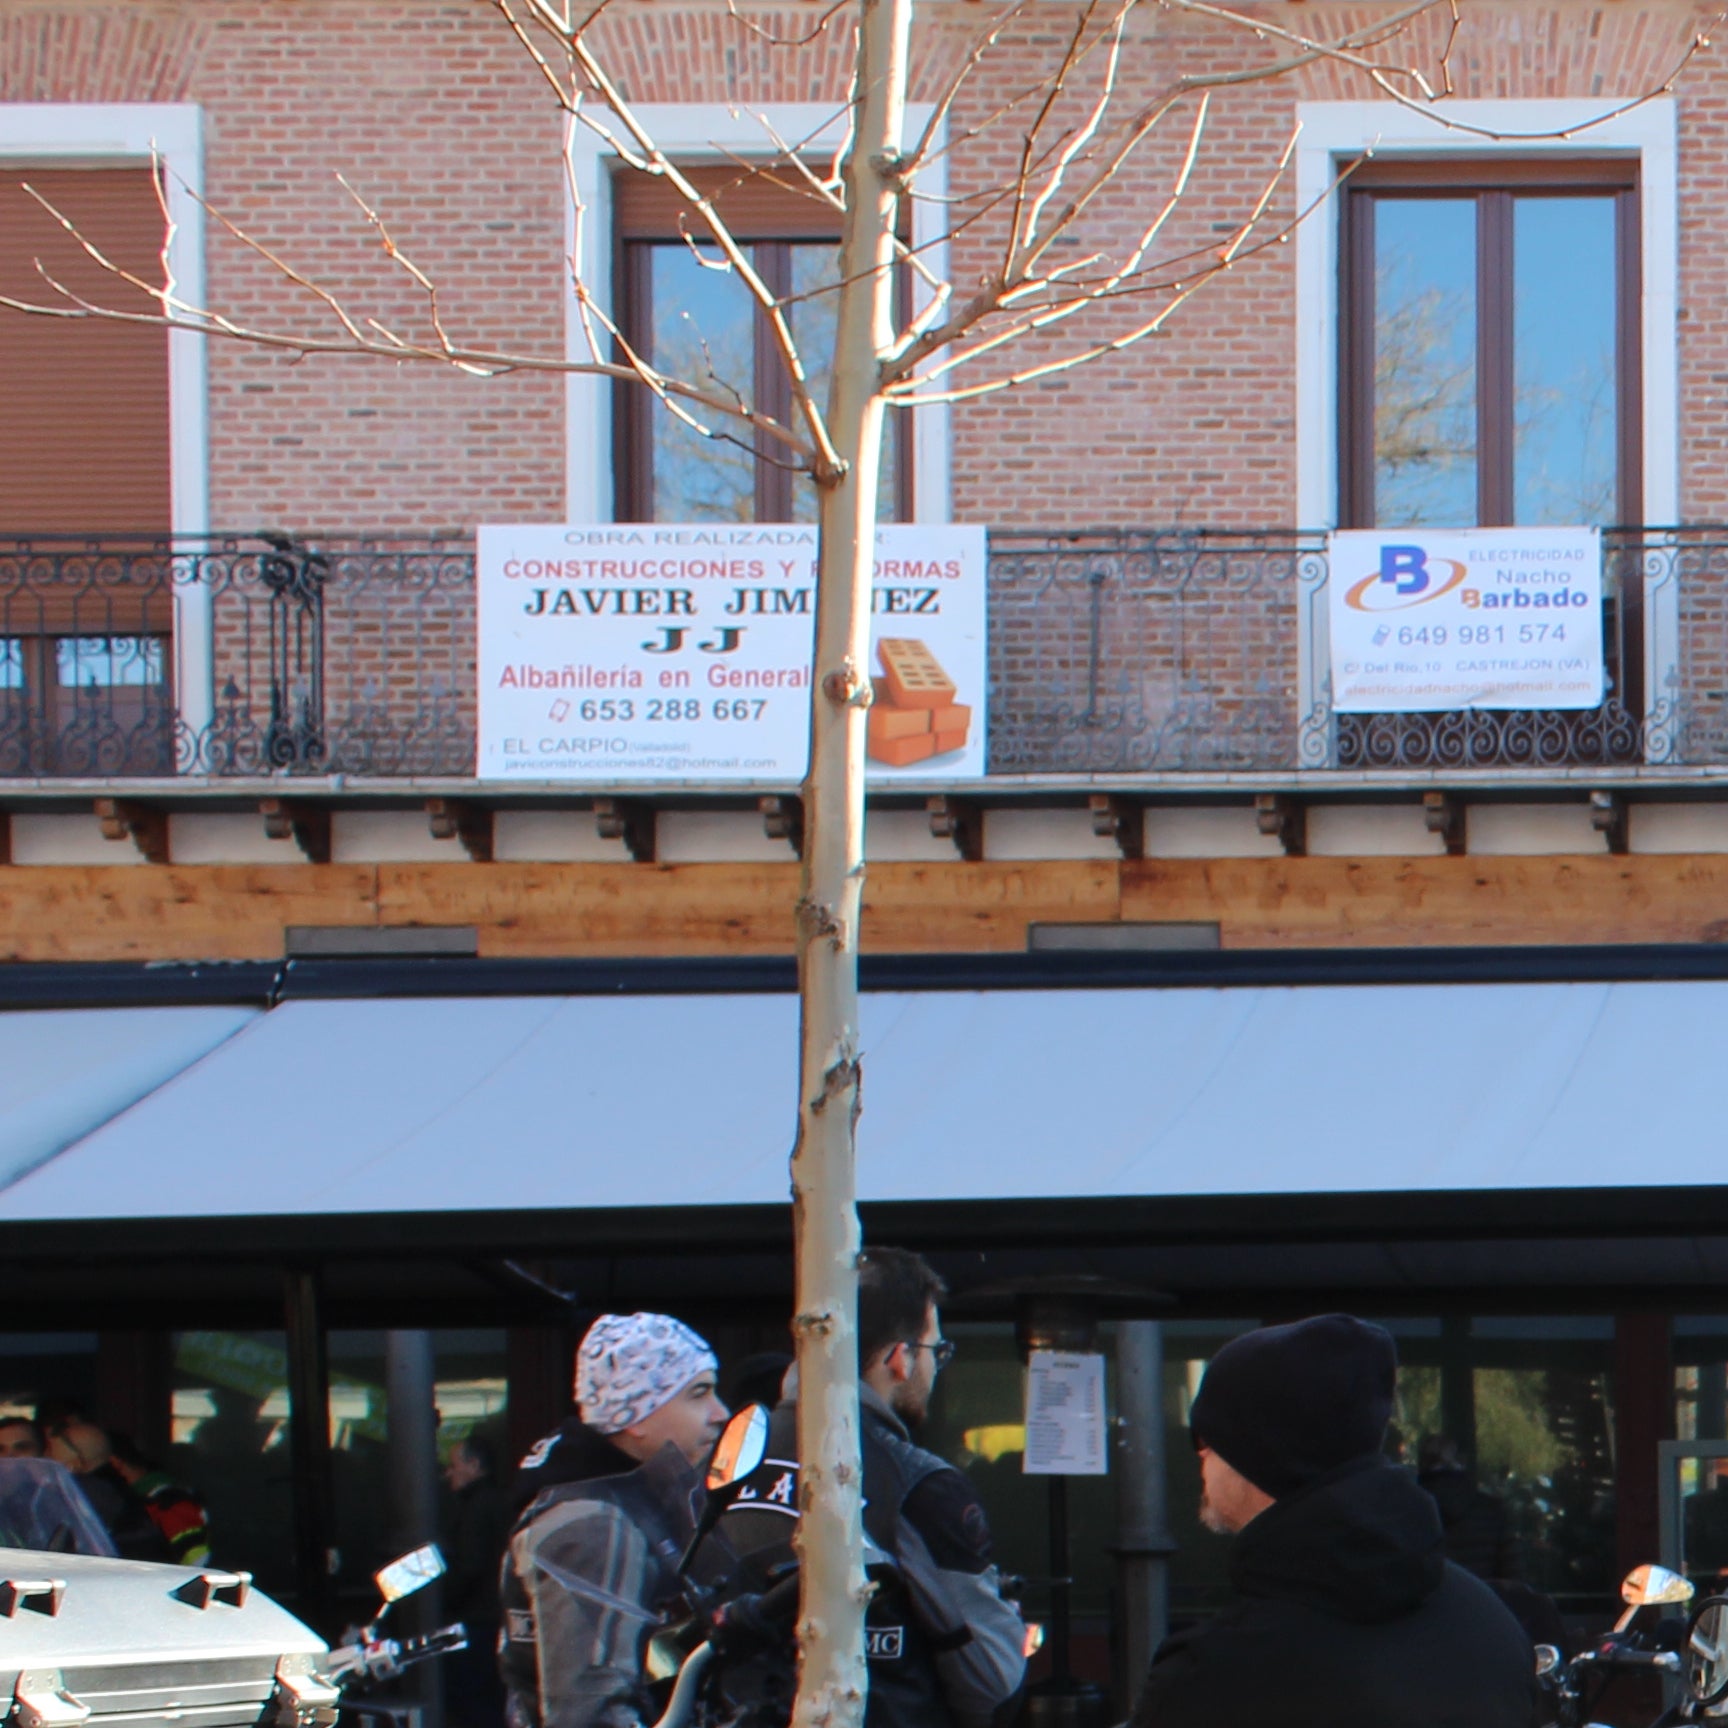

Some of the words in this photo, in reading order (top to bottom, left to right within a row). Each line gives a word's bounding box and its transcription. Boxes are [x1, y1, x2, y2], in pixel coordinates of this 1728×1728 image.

[564, 531, 645, 545] OBRA
[654, 531, 814, 545] REALIZADA
[1469, 550, 1585, 562] ELECTRICIDAD
[503, 559, 765, 579] CONSTRUCCIONES
[779, 559, 796, 579] Y
[1497, 569, 1572, 584] Nacho
[524, 588, 698, 615] JAVIER
[724, 588, 942, 614] JIMEZ
[1461, 588, 1588, 609] Barbado
[1398, 625, 1448, 646] 649
[1458, 625, 1505, 645] 981
[1519, 624, 1567, 644] 574
[1558, 658, 1591, 671] (VA)
[499, 664, 643, 688] Albañilería
[659, 669, 691, 688] en
[707, 664, 810, 688] General
[580, 699, 635, 721] 653
[646, 699, 701, 721] 288
[713, 698, 769, 721] 667
[503, 738, 530, 754] EL
[538, 738, 628, 754] CARPIO
